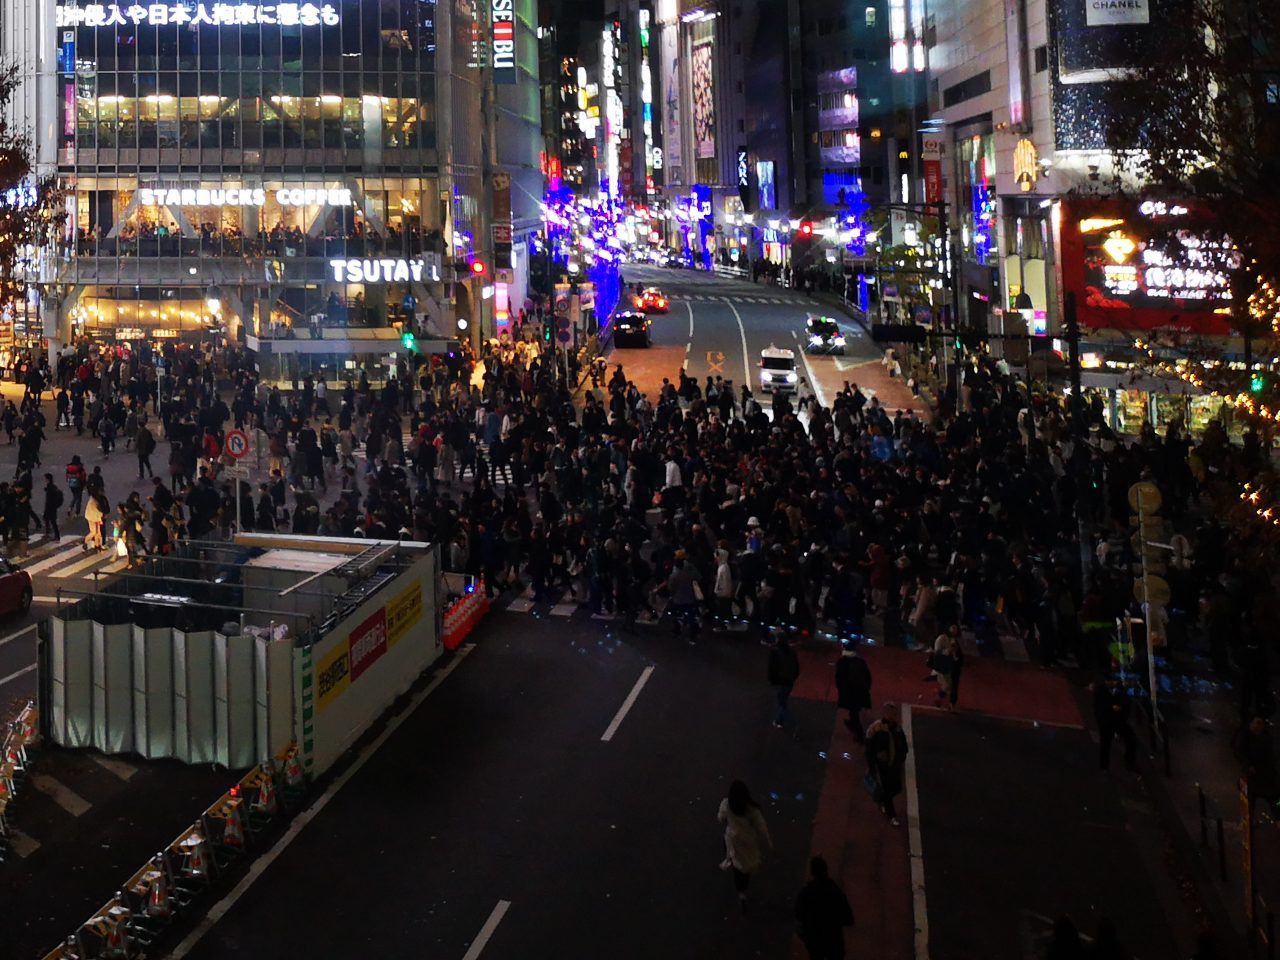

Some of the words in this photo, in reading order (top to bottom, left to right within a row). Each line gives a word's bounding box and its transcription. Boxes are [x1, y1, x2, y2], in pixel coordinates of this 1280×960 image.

[1092, 0, 1141, 9] CHANEL
[738, 151, 748, 186] ZARA
[141, 188, 266, 207] STARBUCKS
[276, 188, 353, 206] COFFEE
